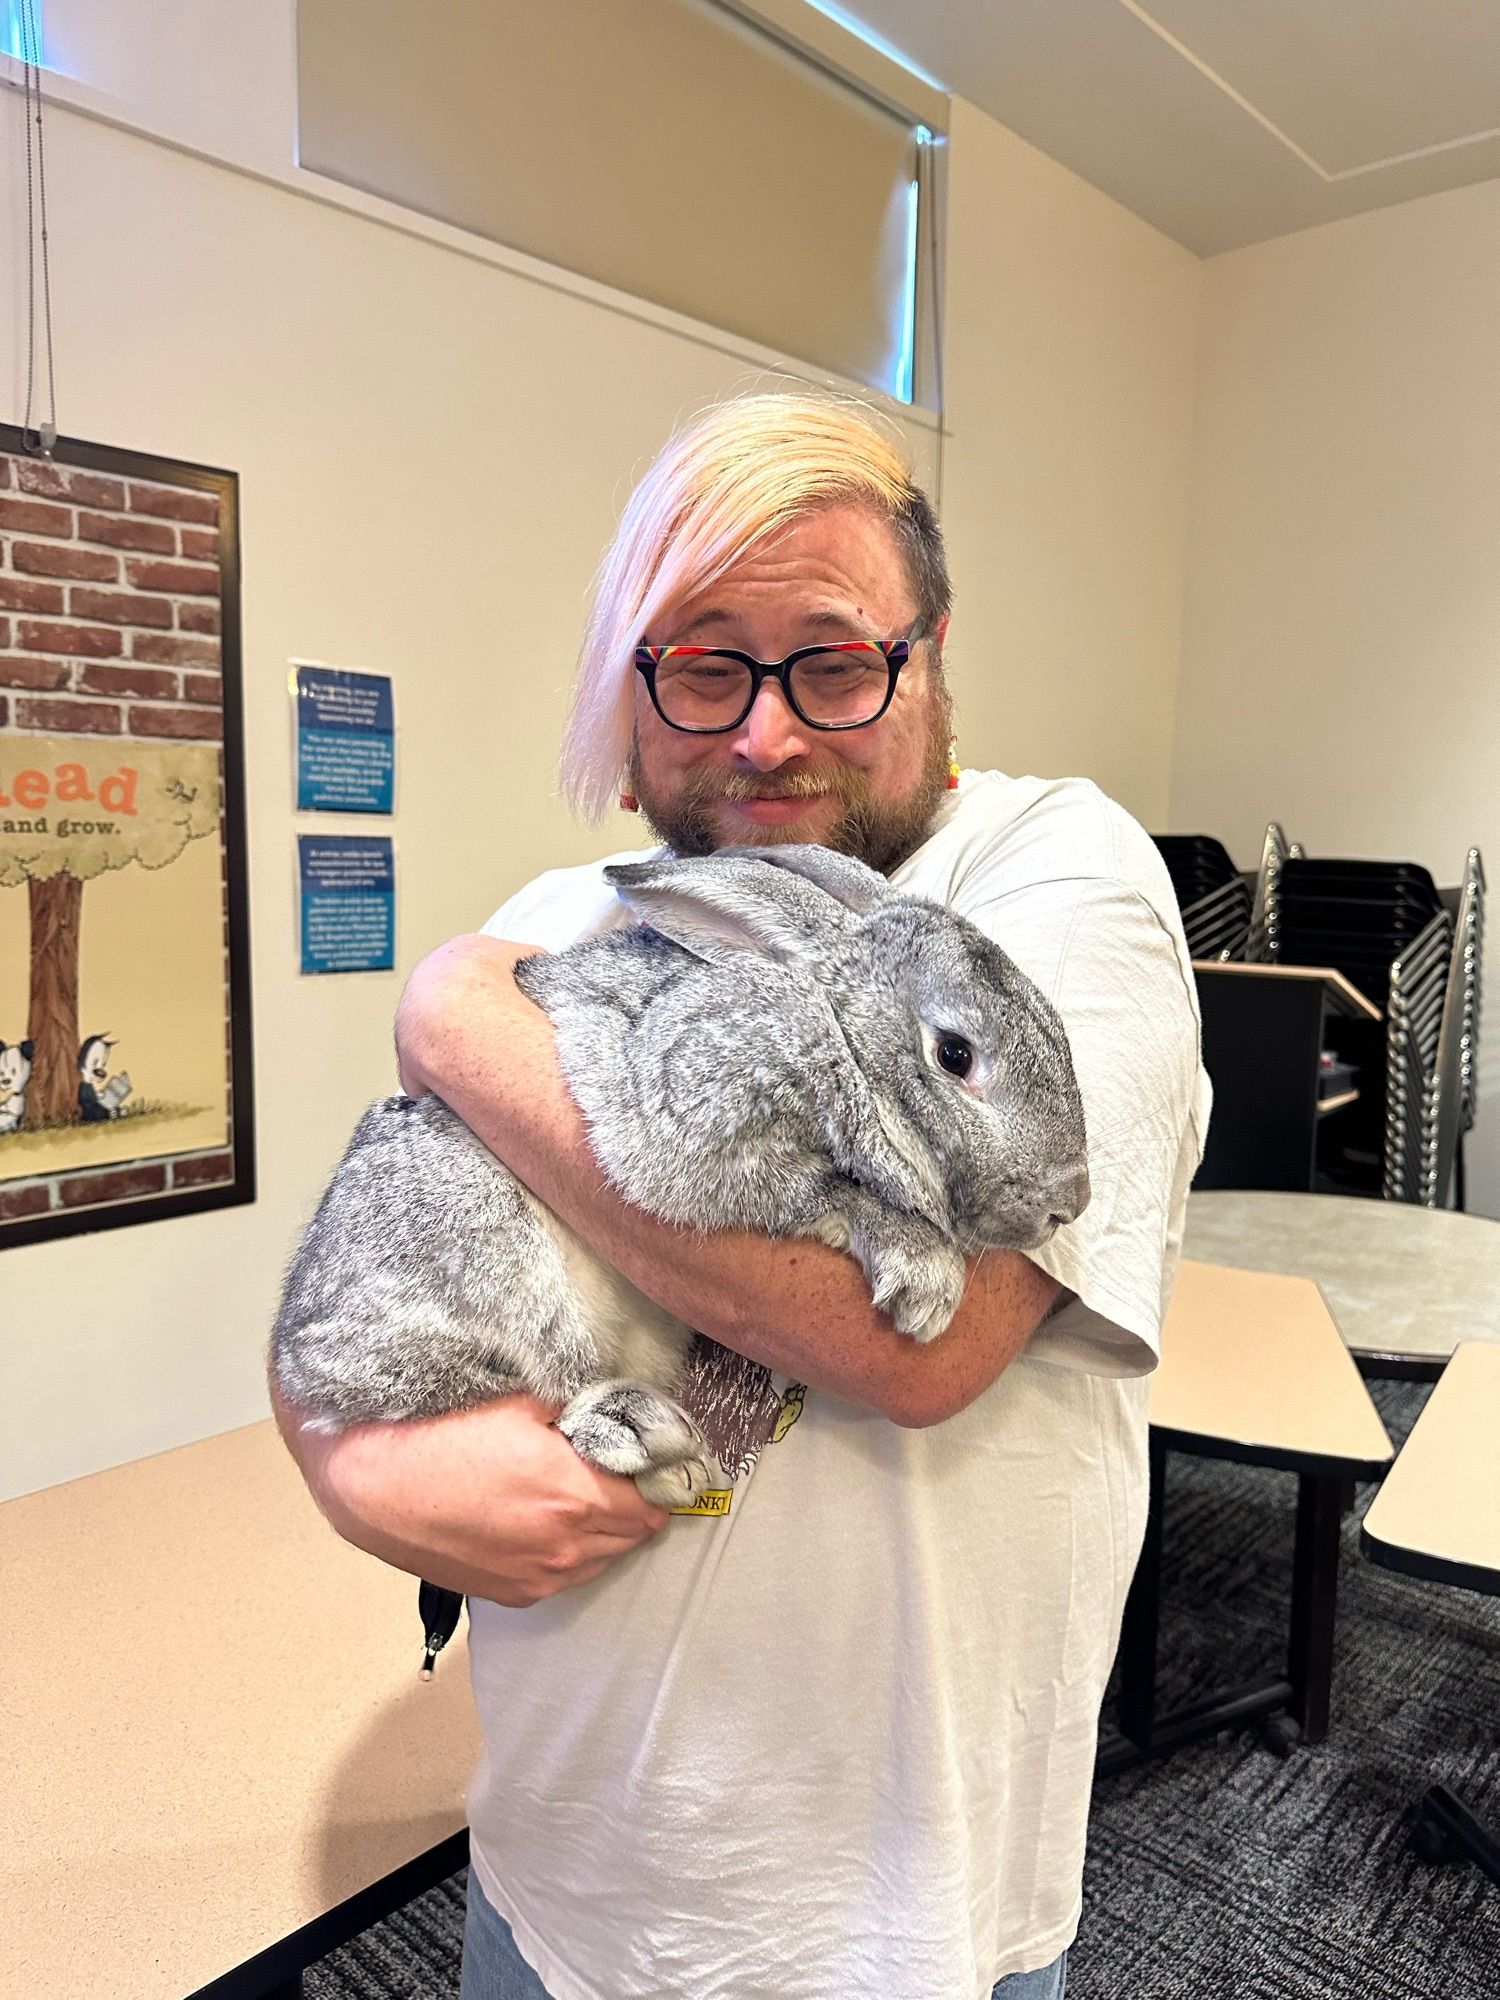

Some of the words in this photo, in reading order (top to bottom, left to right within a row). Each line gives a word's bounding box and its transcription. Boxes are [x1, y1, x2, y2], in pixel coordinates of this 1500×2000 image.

[0, 762, 139, 816] ead
[3, 817, 49, 834] and
[56, 820, 121, 839] grow.
